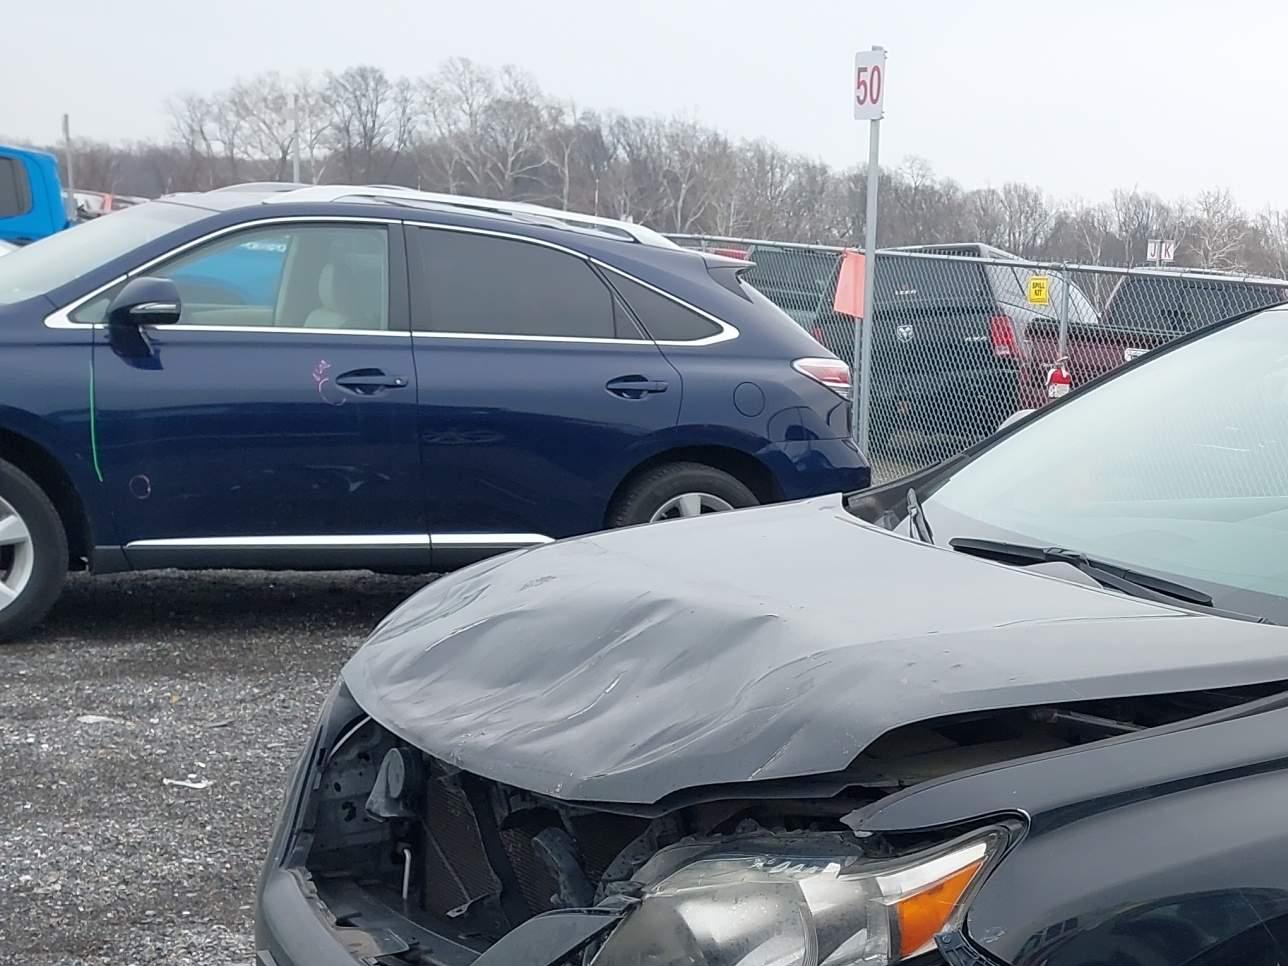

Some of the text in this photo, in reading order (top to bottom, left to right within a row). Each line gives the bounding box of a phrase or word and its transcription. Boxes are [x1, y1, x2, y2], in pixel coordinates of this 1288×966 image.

[856, 65, 882, 105] 50
[1163, 241, 1172, 259] K
[1032, 281, 1045, 289] SPILL
[1034, 289, 1043, 297] KIT
